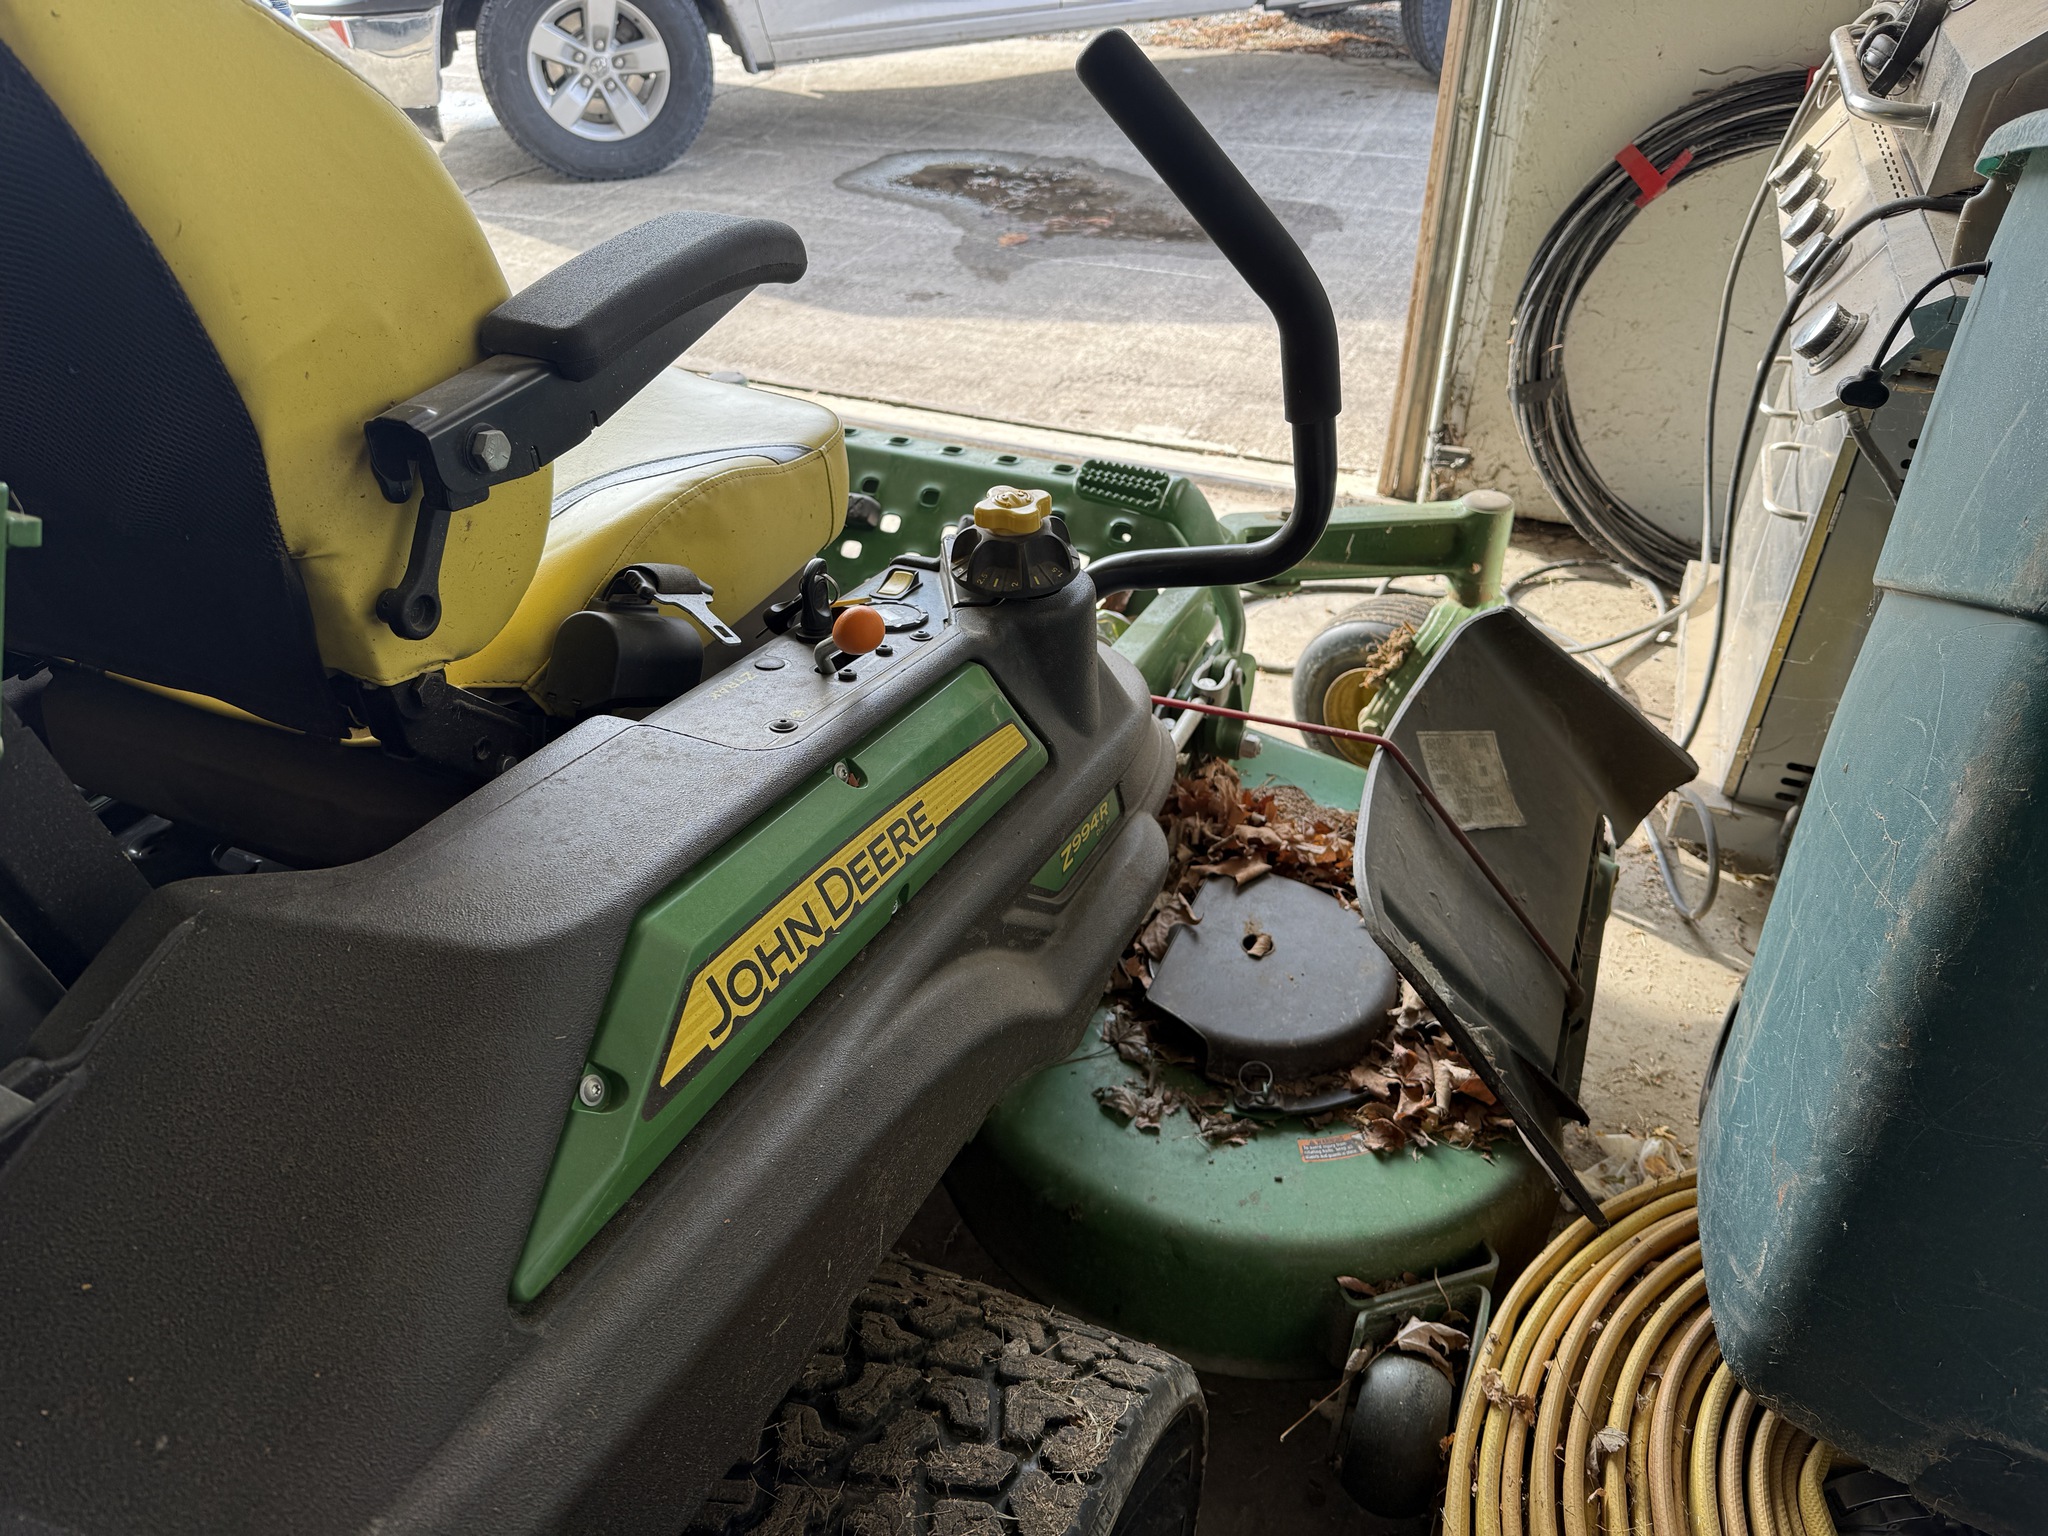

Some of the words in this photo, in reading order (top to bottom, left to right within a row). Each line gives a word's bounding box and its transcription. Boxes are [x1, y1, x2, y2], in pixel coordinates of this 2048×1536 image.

[1060, 801, 1109, 873] Z994R
[705, 901, 824, 1040] JOHN
[814, 800, 936, 922] DEERE
